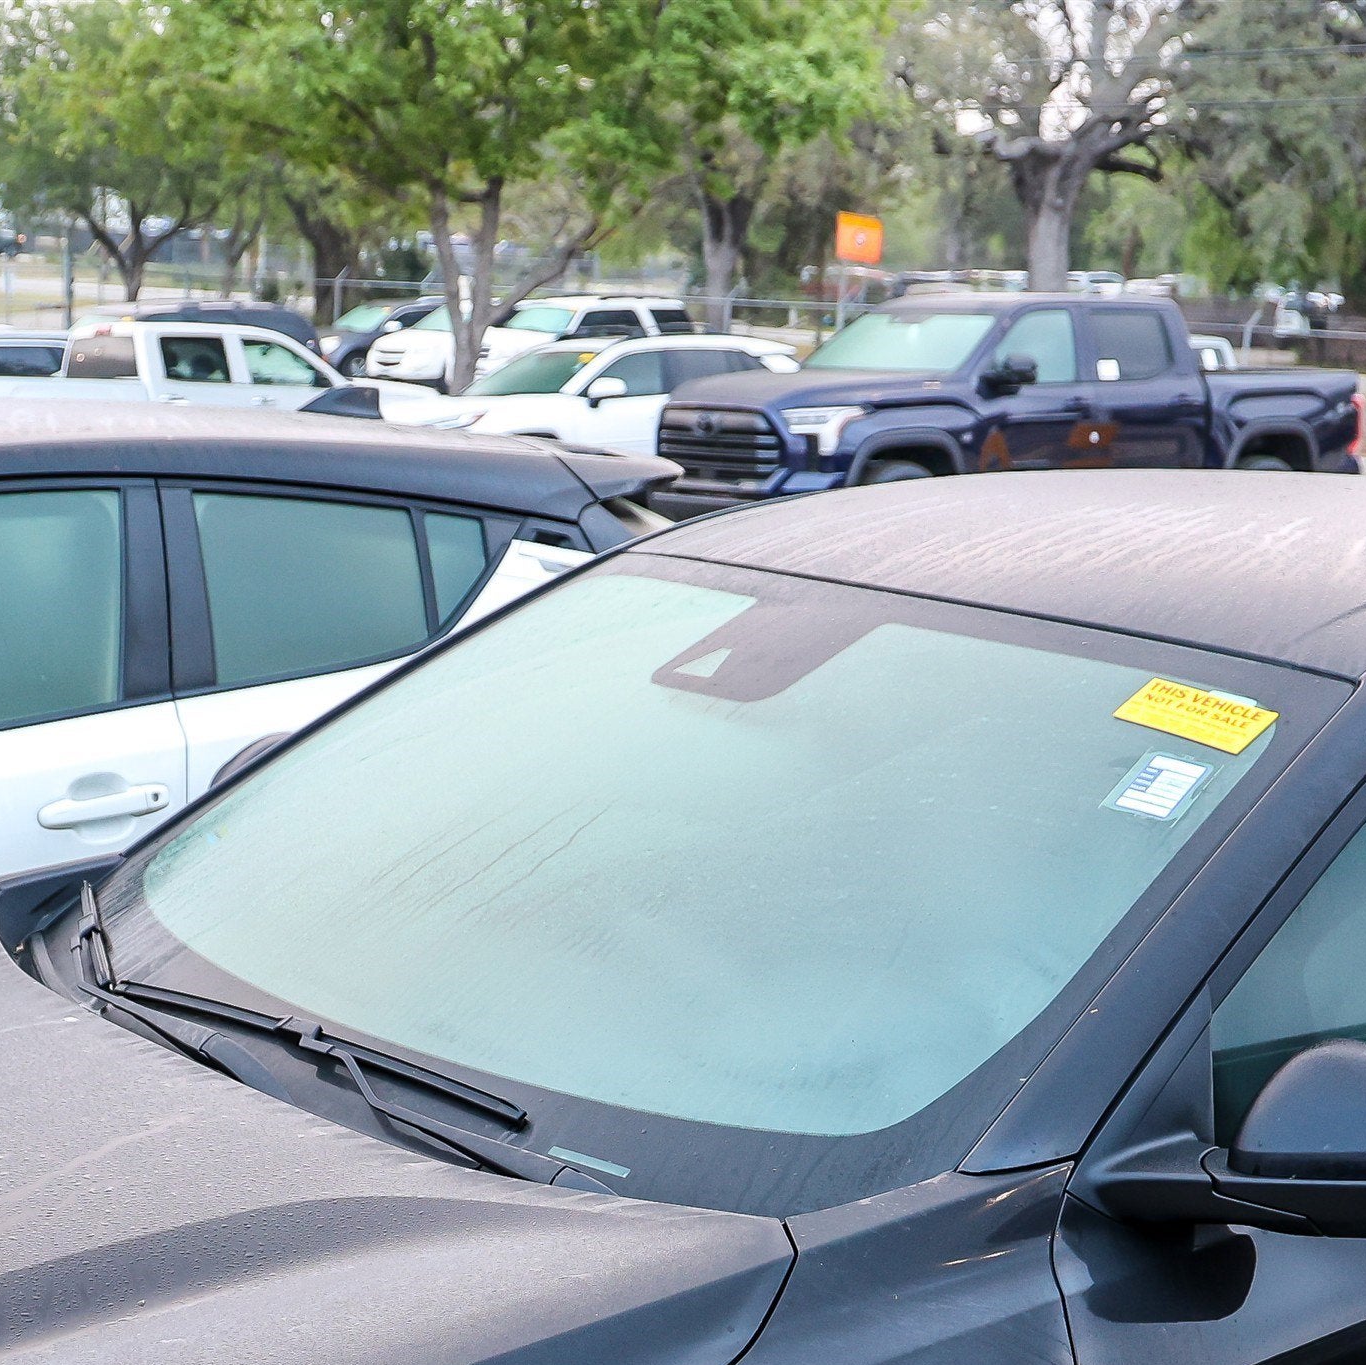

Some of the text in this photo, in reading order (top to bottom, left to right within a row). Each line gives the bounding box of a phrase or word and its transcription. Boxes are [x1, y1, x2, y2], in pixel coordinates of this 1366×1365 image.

[1143, 692, 1250, 730] NOT FOR SALE
[1149, 682, 1264, 722] THIS VEHICLE
